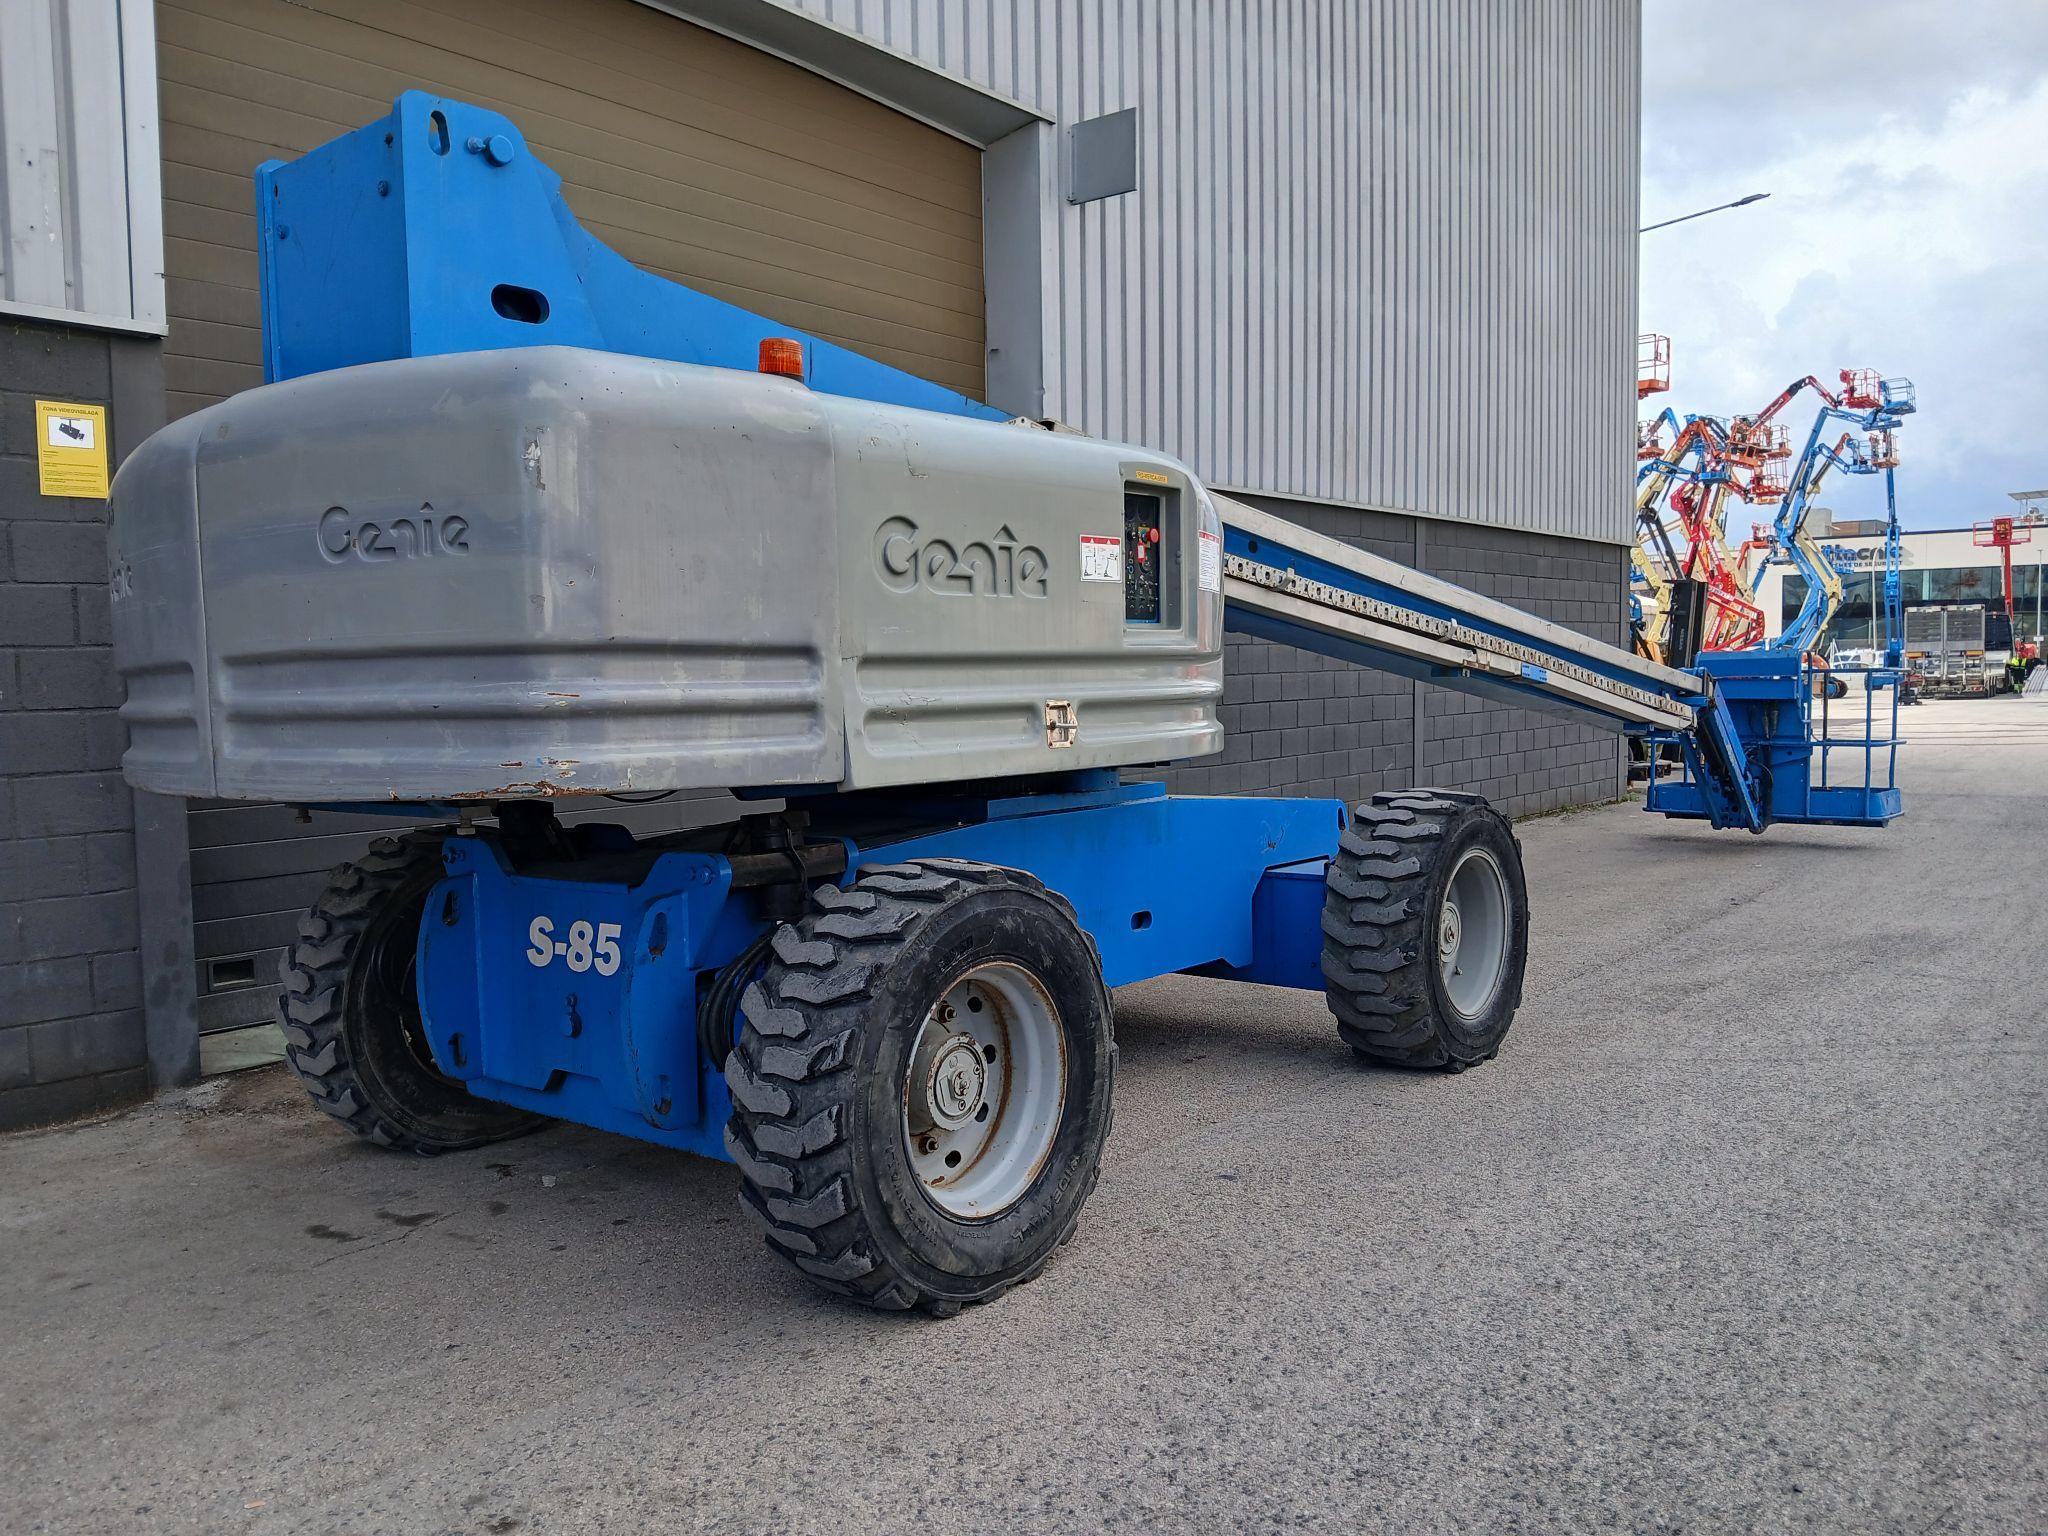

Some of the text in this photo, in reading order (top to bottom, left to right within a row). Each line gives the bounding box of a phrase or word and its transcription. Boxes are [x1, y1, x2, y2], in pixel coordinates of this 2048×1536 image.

[317, 502, 469, 565] Genie
[872, 515, 1050, 600] Genie
[526, 915, 622, 977] S-85
